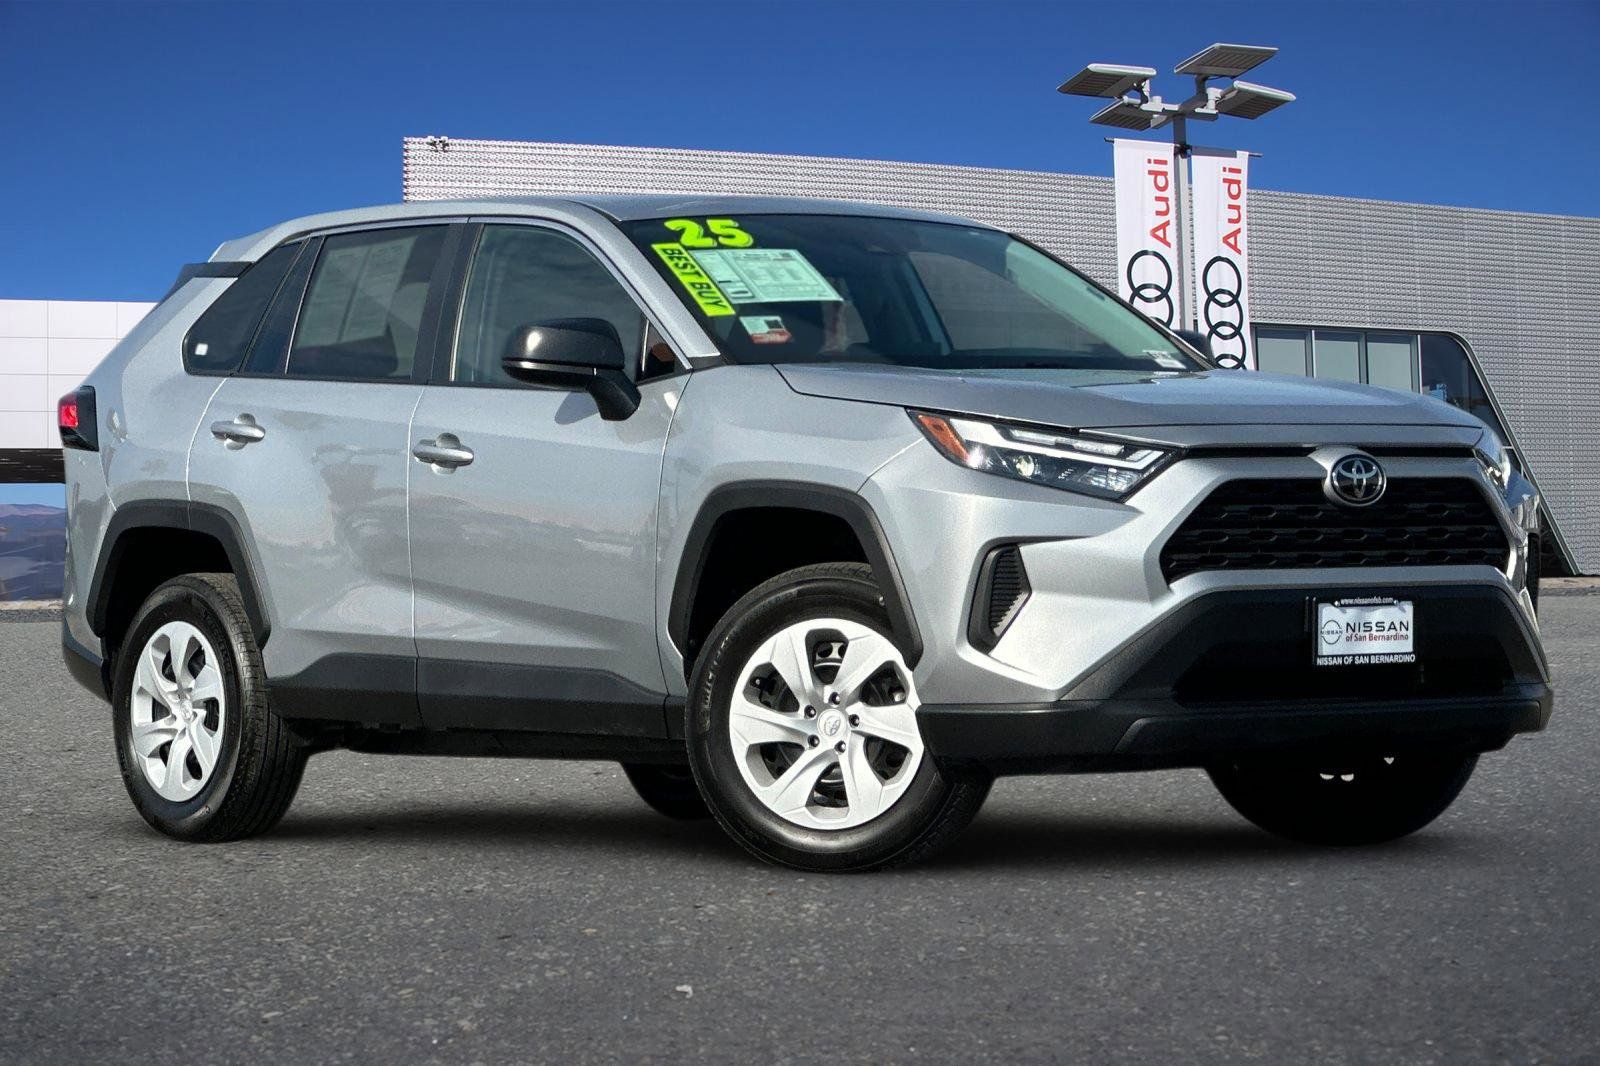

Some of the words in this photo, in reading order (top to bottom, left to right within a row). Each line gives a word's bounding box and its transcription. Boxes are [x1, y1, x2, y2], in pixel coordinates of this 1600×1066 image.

[1147, 158, 1171, 249] Audi
[1222, 166, 1243, 256] Audi
[663, 218, 754, 248] 25
[661, 248, 702, 278] BEST
[690, 281, 728, 310] BUY
[1345, 634, 1353, 642] of
[1353, 633, 1367, 642] San
[1368, 632, 1409, 641] Bernardino
[1346, 621, 1409, 633] NISSAN
[1316, 656, 1342, 666] NISSAN
[1344, 656, 1354, 665] OF
[1354, 656, 1370, 665] SAN
[1370, 654, 1416, 664] BERNARDINO
